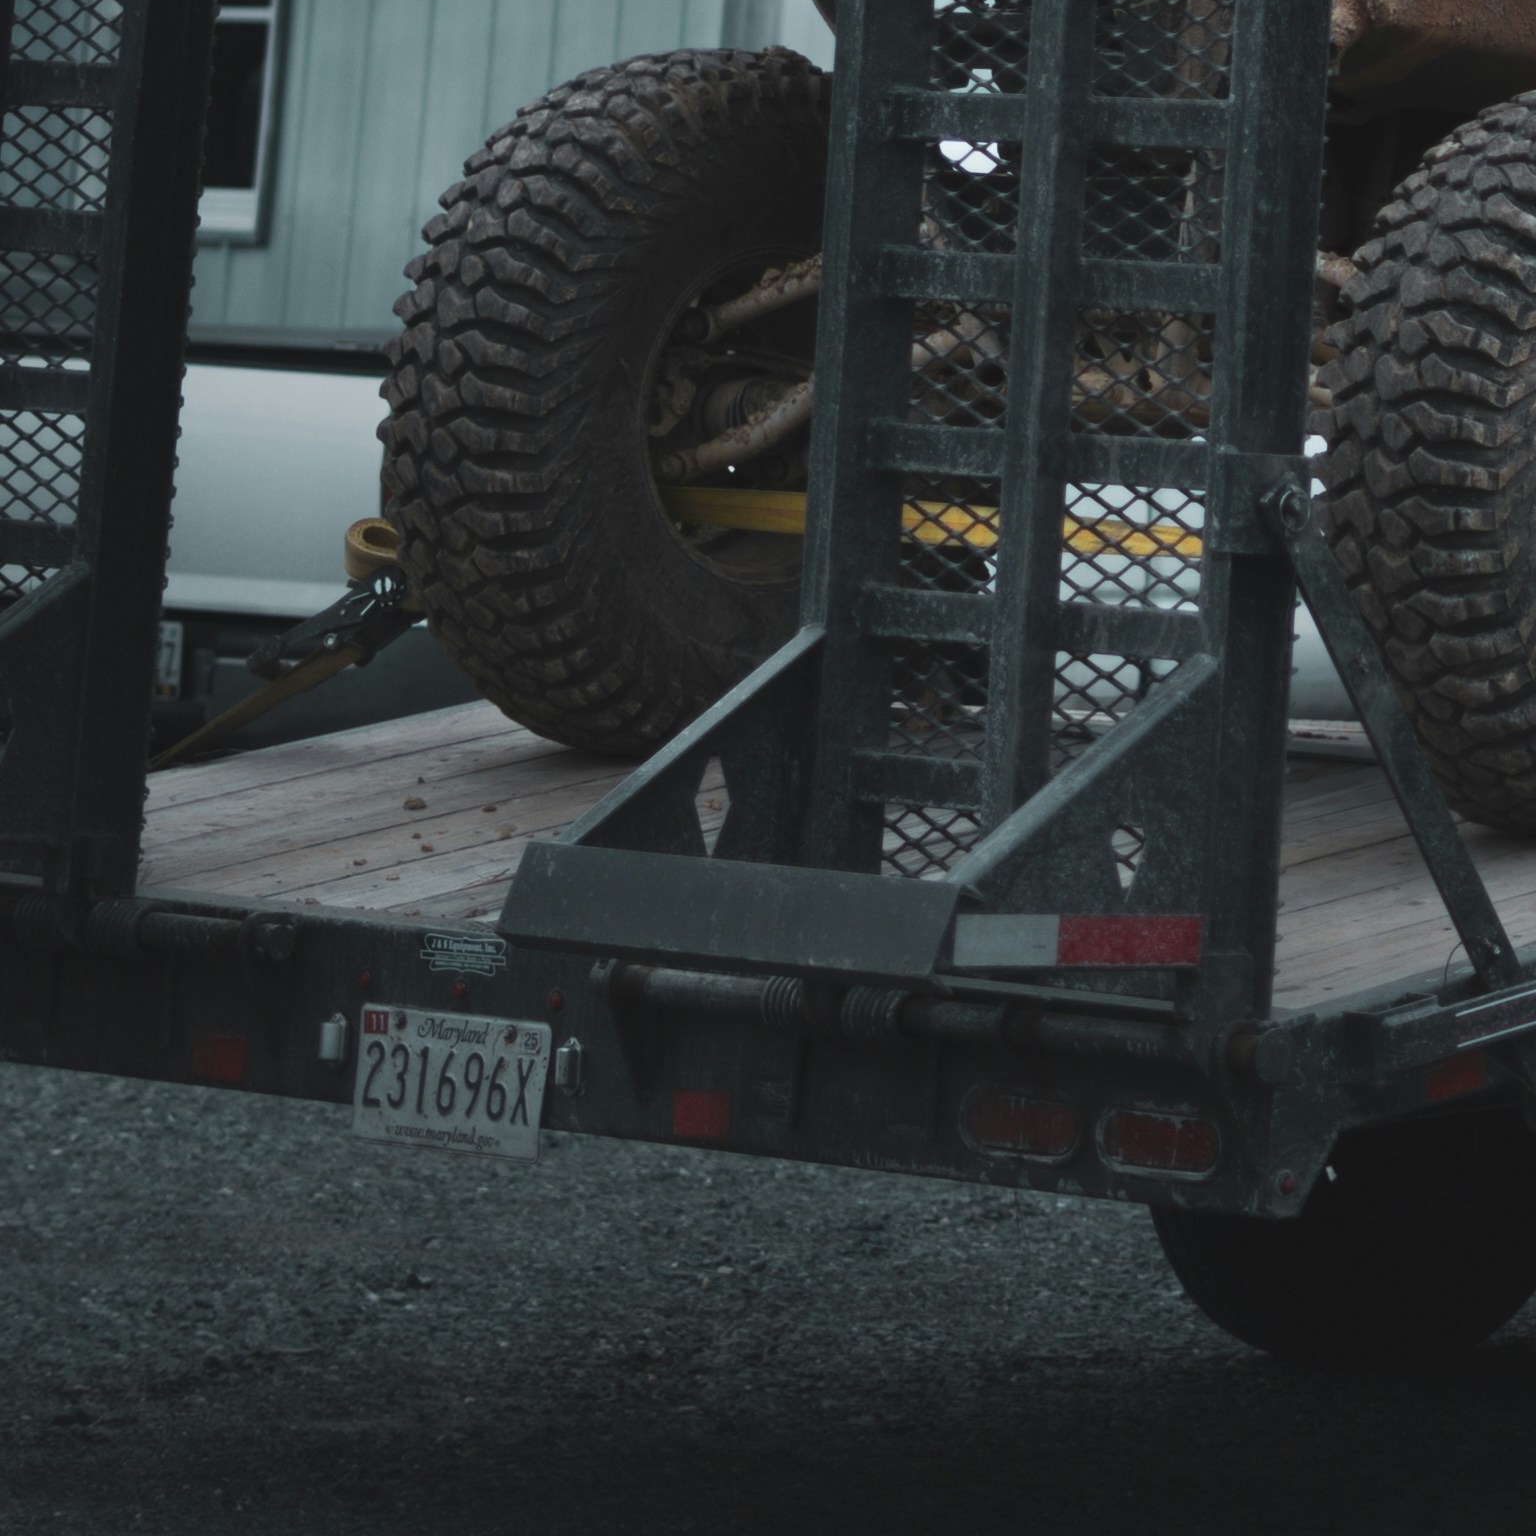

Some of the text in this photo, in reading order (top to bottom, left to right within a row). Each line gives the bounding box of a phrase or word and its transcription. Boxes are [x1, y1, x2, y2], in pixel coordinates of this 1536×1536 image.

[371, 1013, 386, 1032] 11
[416, 1018, 488, 1046] Maryland
[523, 1031, 539, 1050] 25
[362, 1040, 535, 1127] 231696X
[394, 1122, 495, 1152] www.maryland.gov
